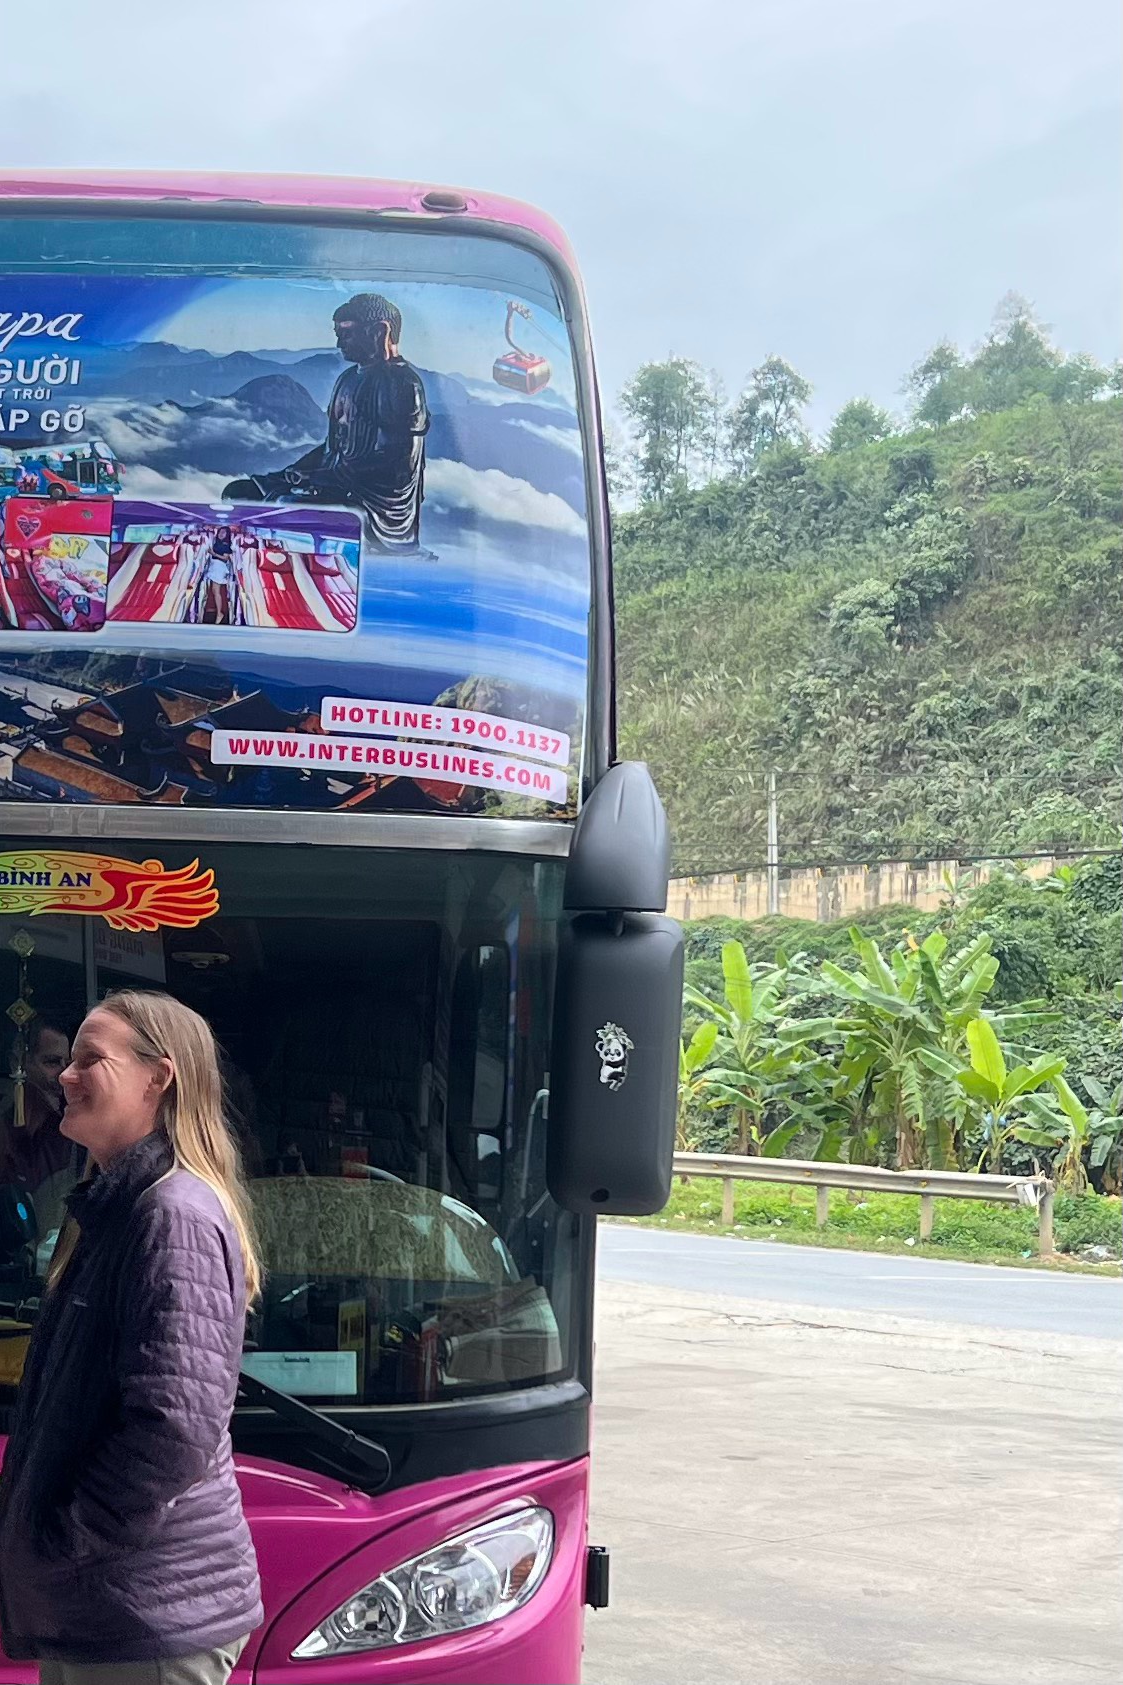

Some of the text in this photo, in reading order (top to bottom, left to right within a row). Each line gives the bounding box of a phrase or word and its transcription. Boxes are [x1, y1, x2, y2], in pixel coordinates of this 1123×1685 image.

[12, 386, 52, 401] TRỜI
[39, 403, 87, 433] GỠ
[330, 704, 562, 754] HOTLINE: 1900.1137
[227, 737, 552, 792] WWW.INTERBUSLINES.COM
[57, 871, 93, 888] AN
